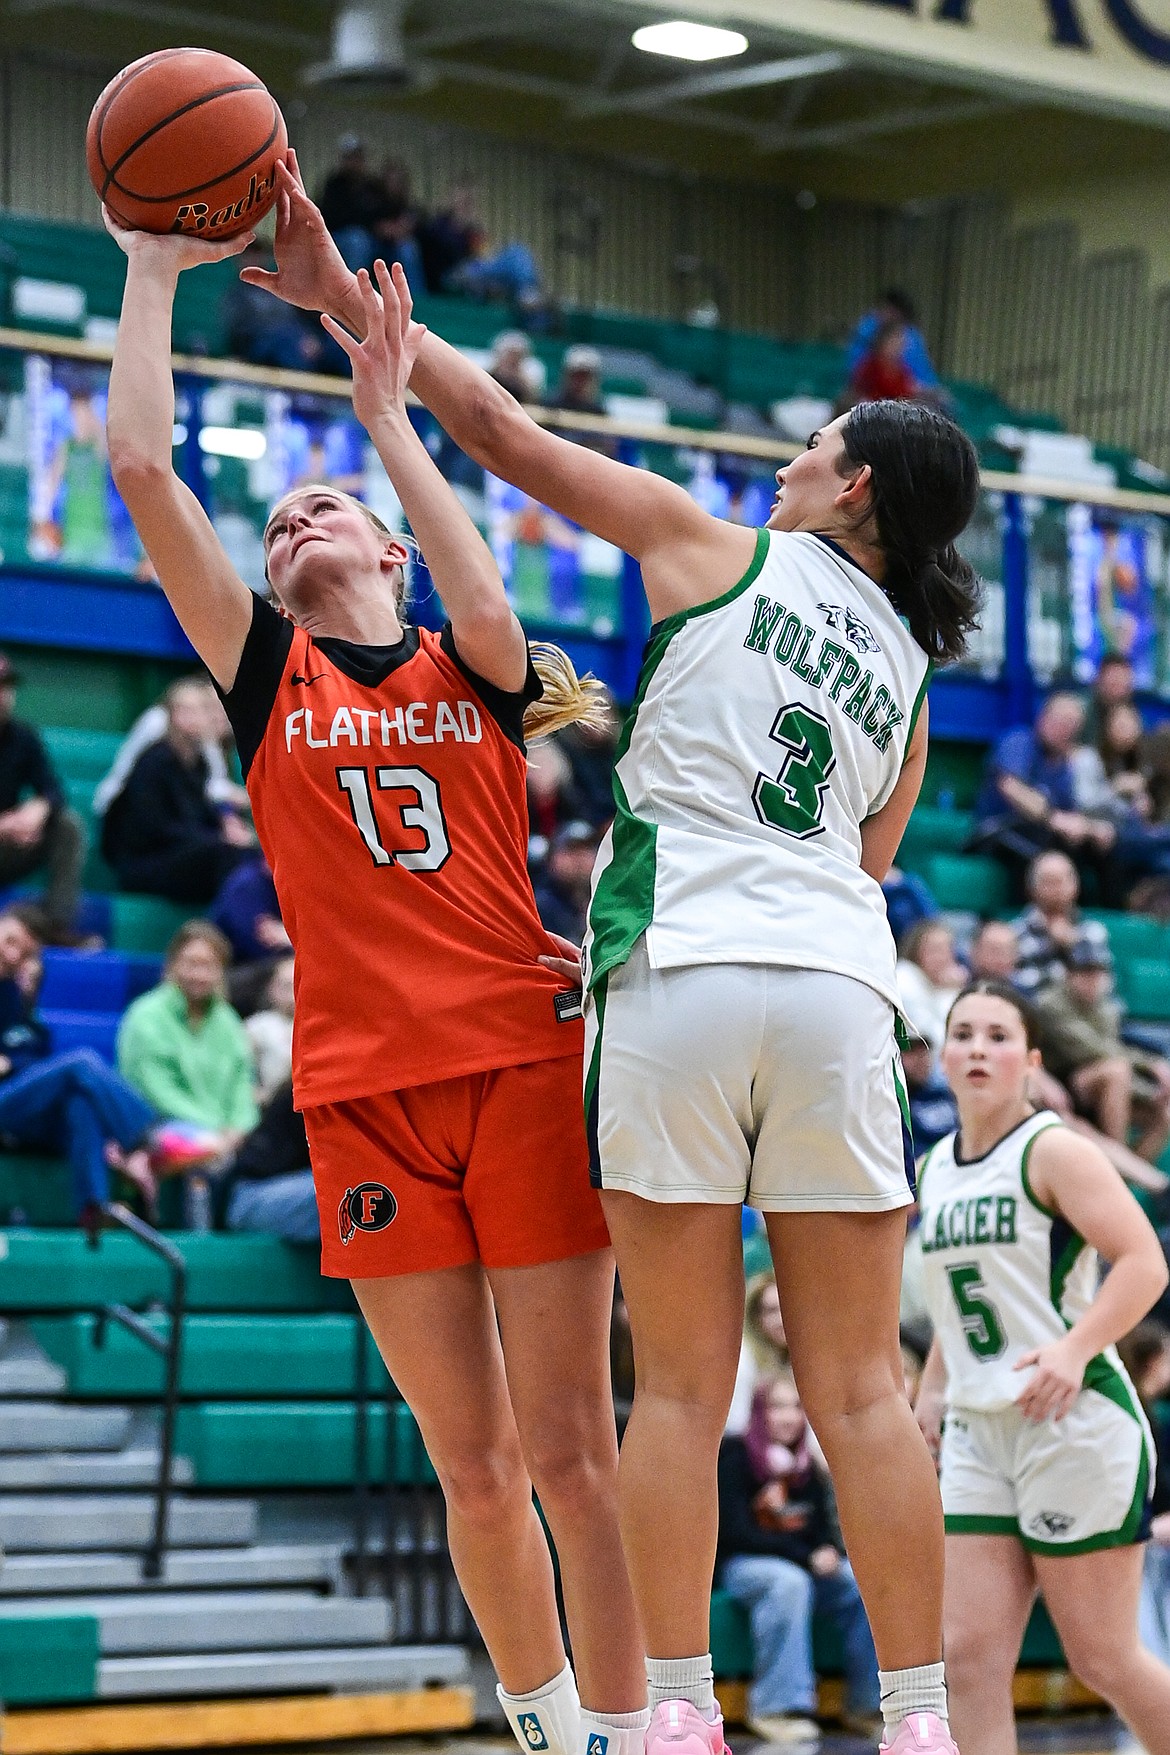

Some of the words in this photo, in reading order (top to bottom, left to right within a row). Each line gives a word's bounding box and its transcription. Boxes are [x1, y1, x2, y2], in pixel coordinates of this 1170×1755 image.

[743, 594, 904, 755] WOLFPACK
[285, 700, 483, 754] FLATHEAD
[751, 702, 837, 840] 3
[335, 764, 453, 872] 13
[361, 1190, 383, 1224] F
[921, 1196, 1018, 1253] LACIER
[944, 1261, 1009, 1364] 5
